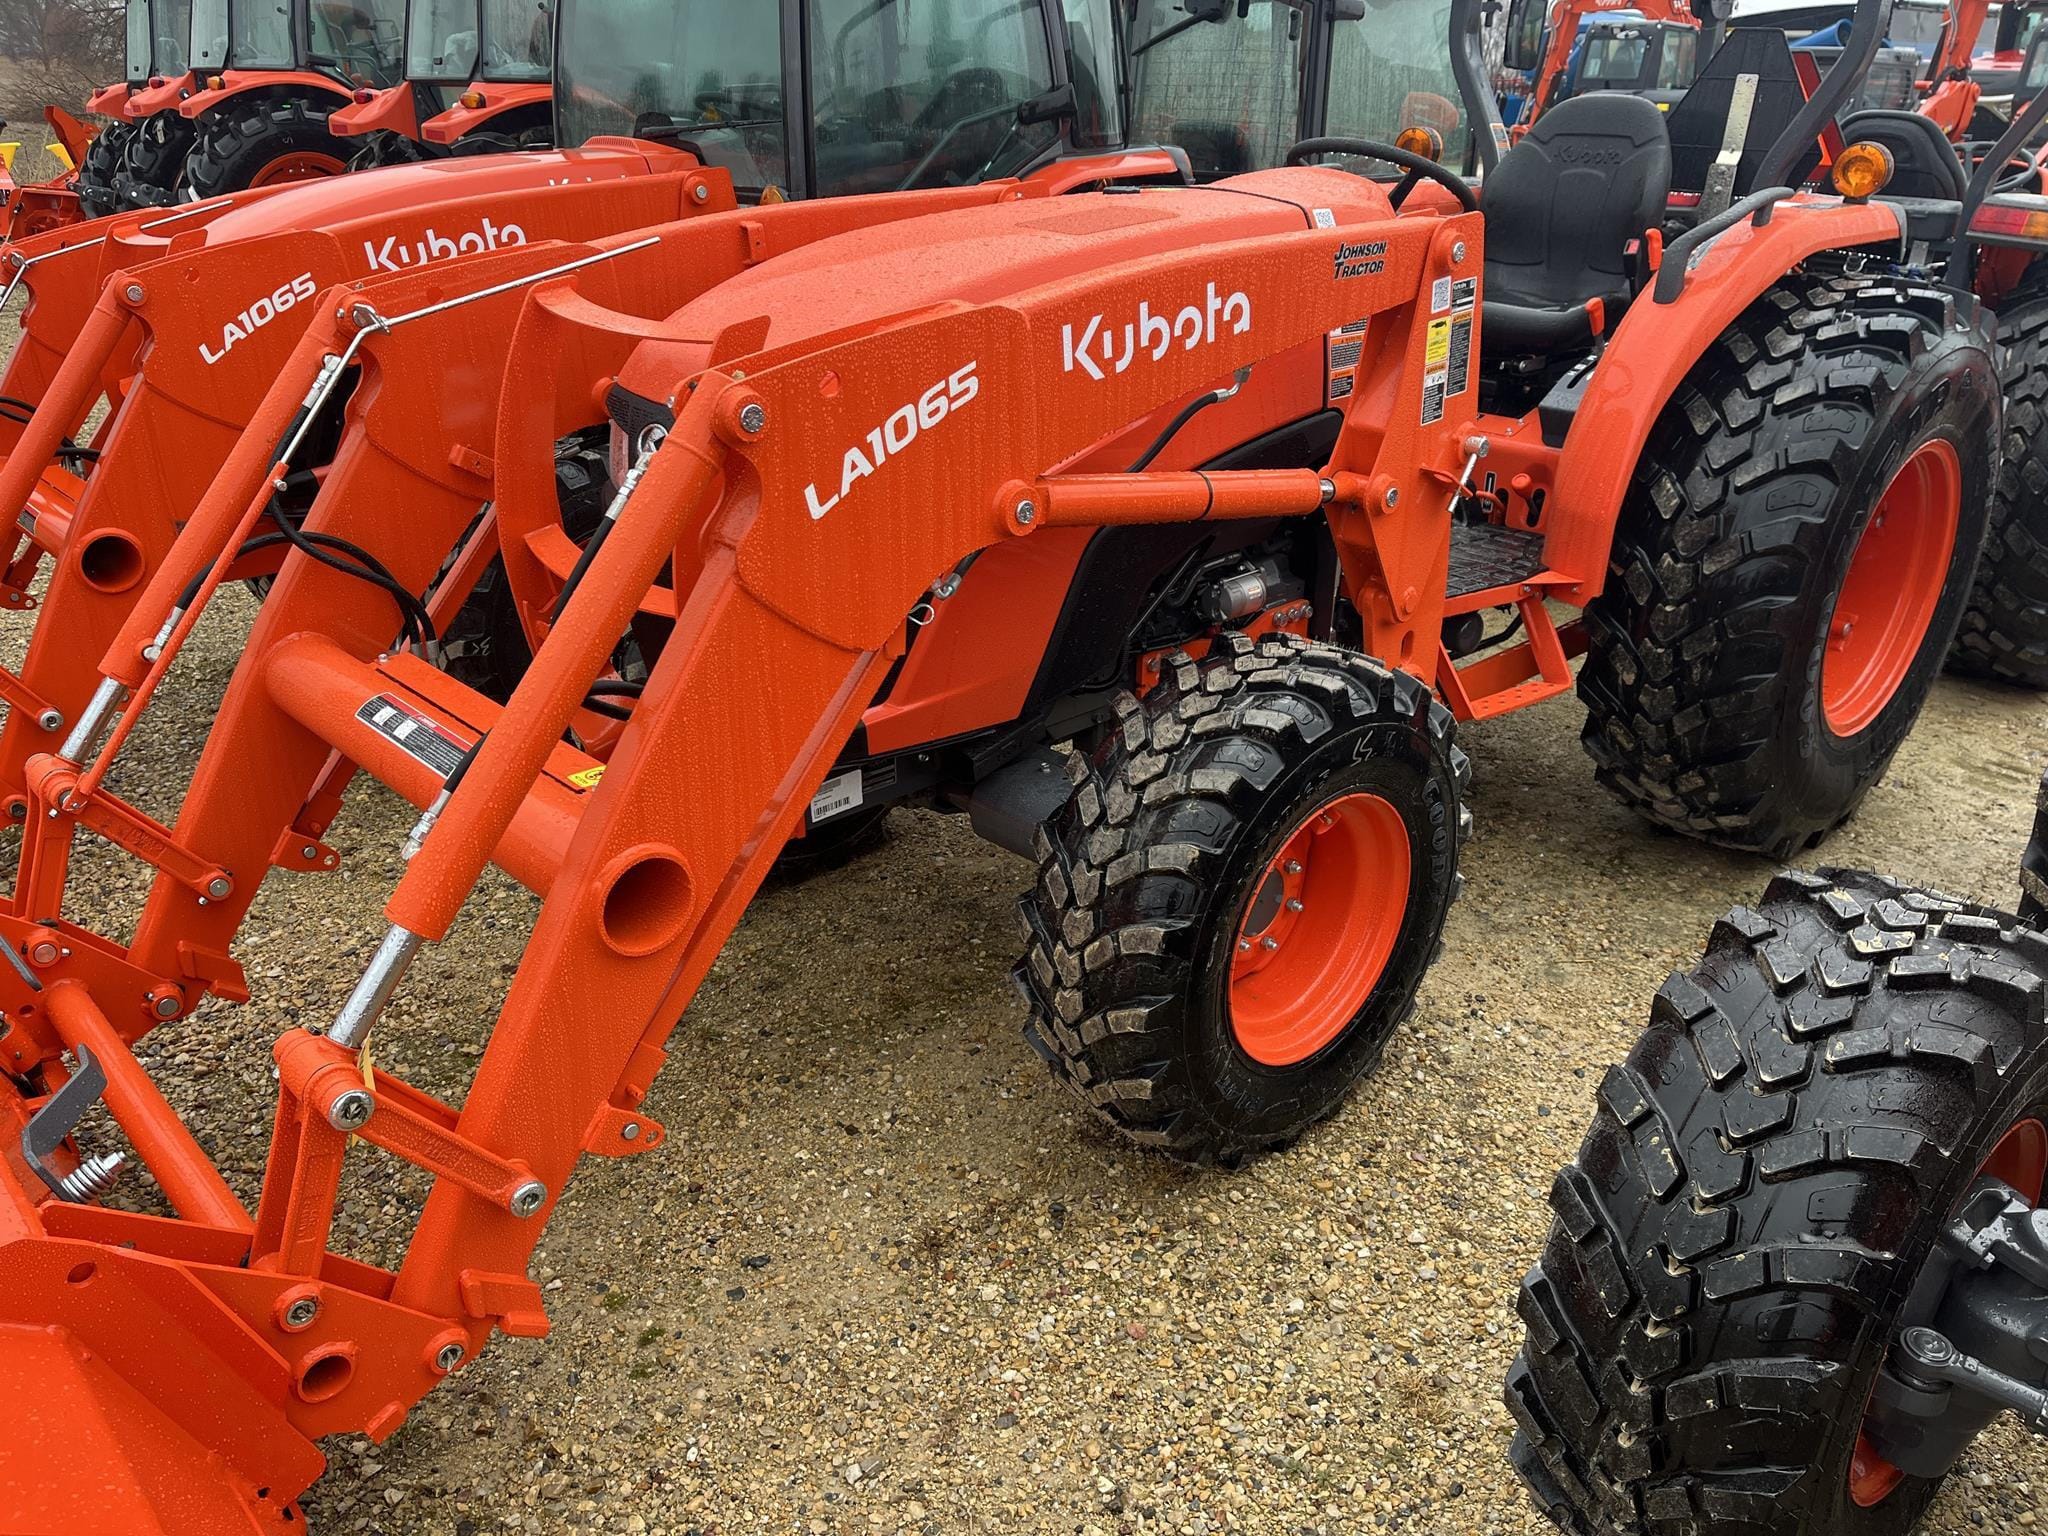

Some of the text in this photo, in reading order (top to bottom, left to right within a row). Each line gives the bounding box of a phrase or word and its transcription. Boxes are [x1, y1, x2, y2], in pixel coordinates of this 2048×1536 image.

[363, 217, 527, 272] Kubota
[1335, 242, 1387, 260] JOHNSON
[1335, 261, 1384, 279] TRACTOR
[198, 271, 318, 365] LA1065
[1061, 282, 1252, 381] Kubota
[804, 360, 980, 520] LA1065
